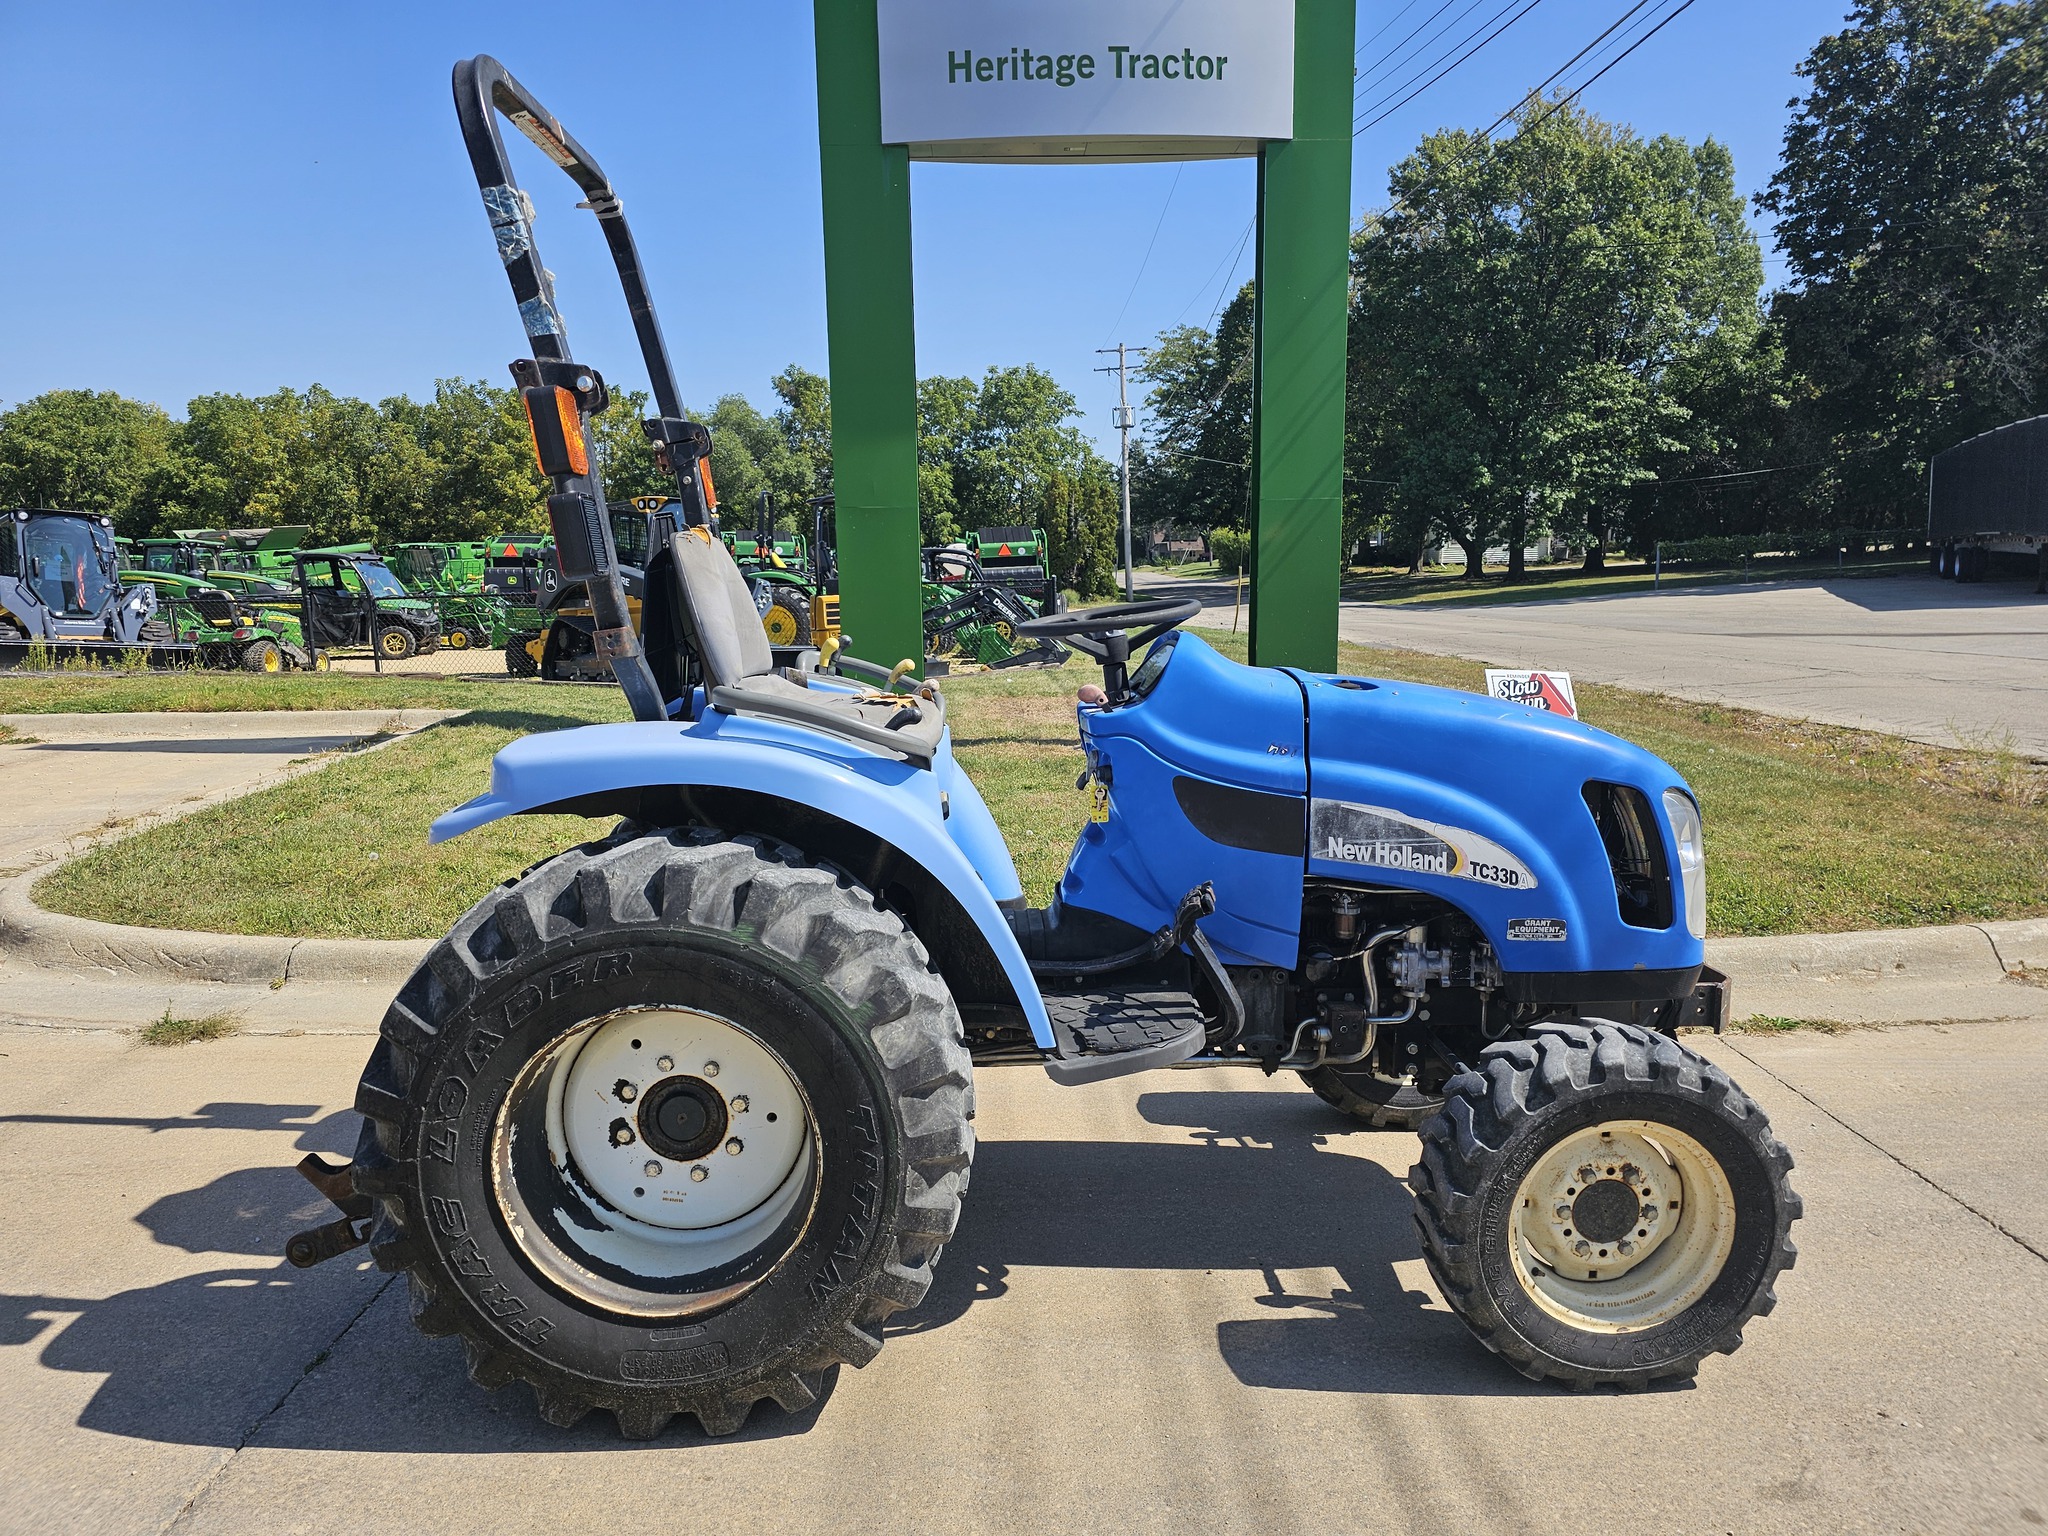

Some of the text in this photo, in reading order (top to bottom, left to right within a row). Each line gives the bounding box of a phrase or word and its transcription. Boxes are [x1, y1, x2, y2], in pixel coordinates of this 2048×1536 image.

[948, 45, 1228, 86] Heritage Tractor
[992, 597, 1018, 621] DEERE
[1497, 679, 1543, 698] Slow
[1328, 836, 1447, 873] New Holland
[1524, 919, 1551, 927] GRANT
[430, 951, 634, 1345] TRAC LOADER
[808, 1104, 879, 1301] TITAN
